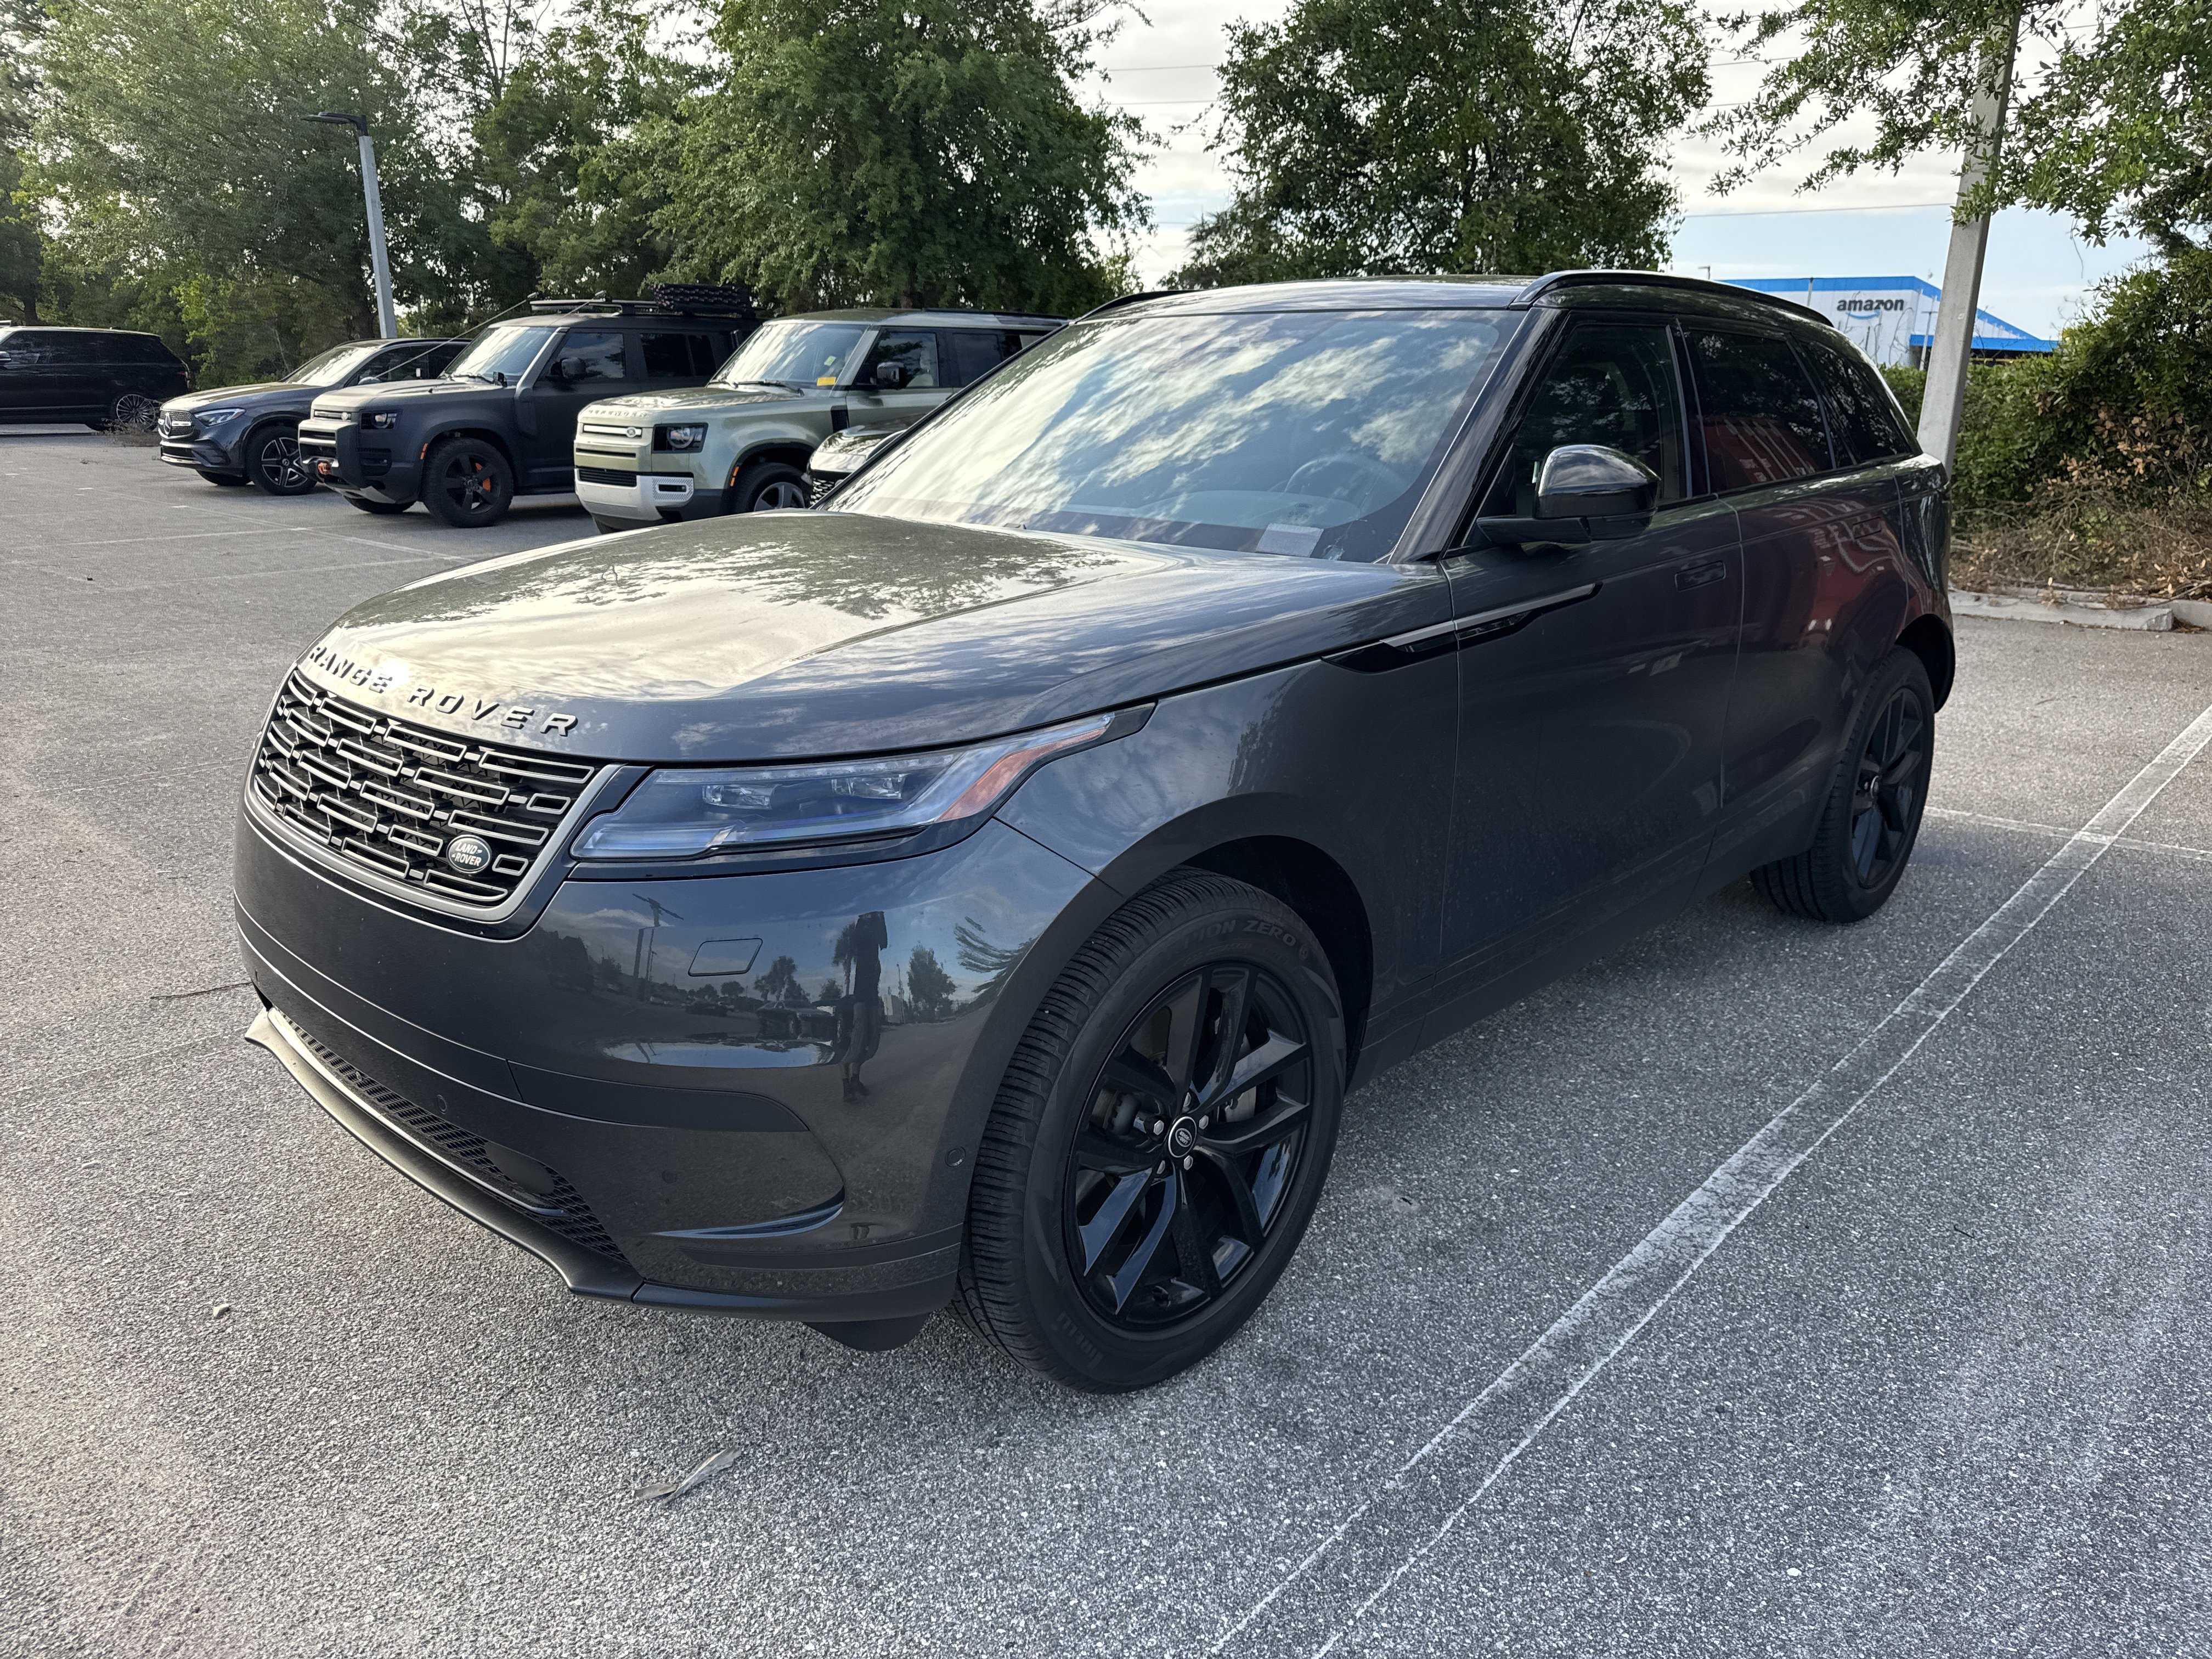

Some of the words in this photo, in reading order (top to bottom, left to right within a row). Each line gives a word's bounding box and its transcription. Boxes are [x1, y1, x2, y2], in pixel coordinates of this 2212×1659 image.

[1836, 299, 1904, 311] amazon
[309, 646, 393, 694] RANGE
[407, 684, 579, 737] ROVER
[455, 842, 478, 855] LAND
[454, 852, 482, 867] ROVER
[1242, 919, 1296, 947] ZERO
